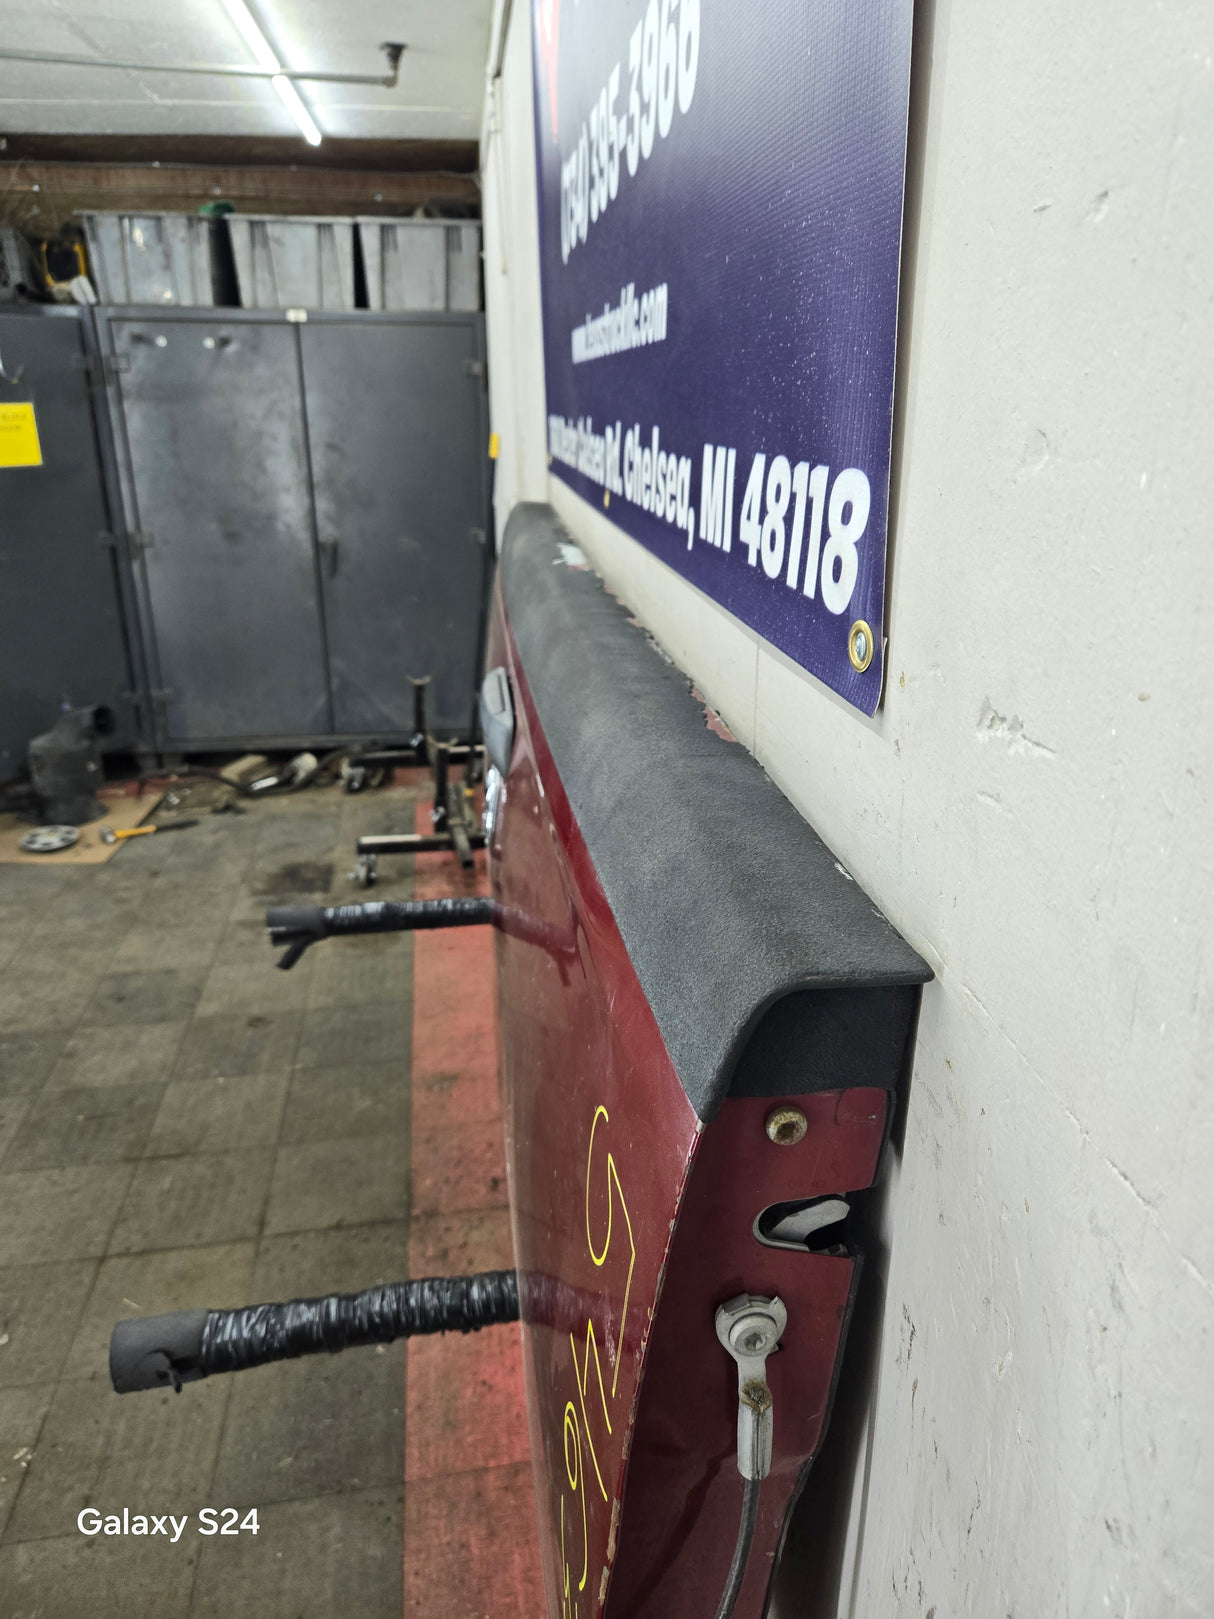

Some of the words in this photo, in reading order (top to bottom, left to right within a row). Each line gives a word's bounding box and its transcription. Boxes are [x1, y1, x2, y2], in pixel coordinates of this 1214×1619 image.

[623, 422, 695, 551] Chelsea,
[699, 443, 737, 553] MI
[739, 455, 871, 615] 48118
